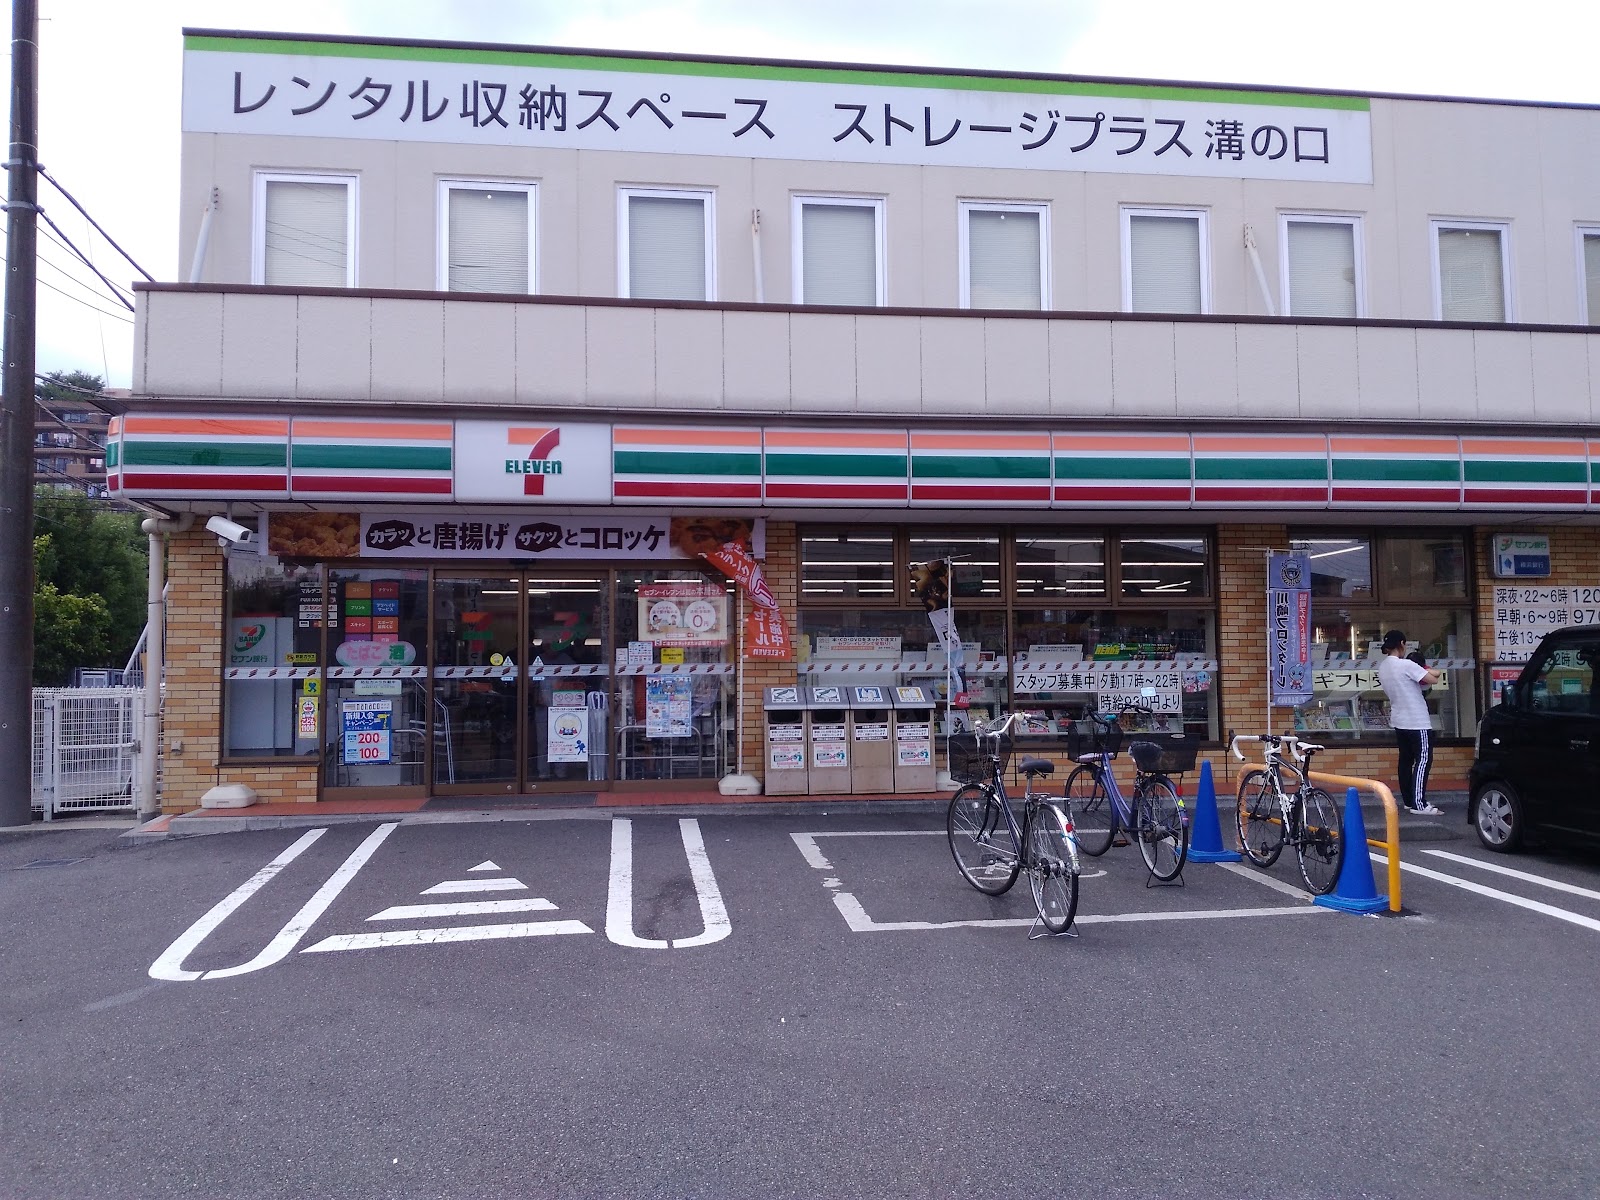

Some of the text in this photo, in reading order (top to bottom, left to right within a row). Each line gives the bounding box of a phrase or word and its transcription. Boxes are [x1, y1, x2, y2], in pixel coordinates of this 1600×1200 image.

[232, 70, 776, 139] レンタル収納スペース
[1515, 541, 1547, 549] セブン銀行
[1497, 629, 1550, 646] 午後13～
[346, 645, 382, 660] たばこ
[388, 644, 406, 660] 酒
[230, 654, 268, 664] セブン銀行
[1015, 673, 1096, 690] スタッフ募集中
[301, 717, 316, 725] こども
[345, 711, 375, 720] 新規入会
[345, 719, 374, 727] キャンペーン
[358, 732, 380, 744] 200
[359, 747, 379, 759] 100
